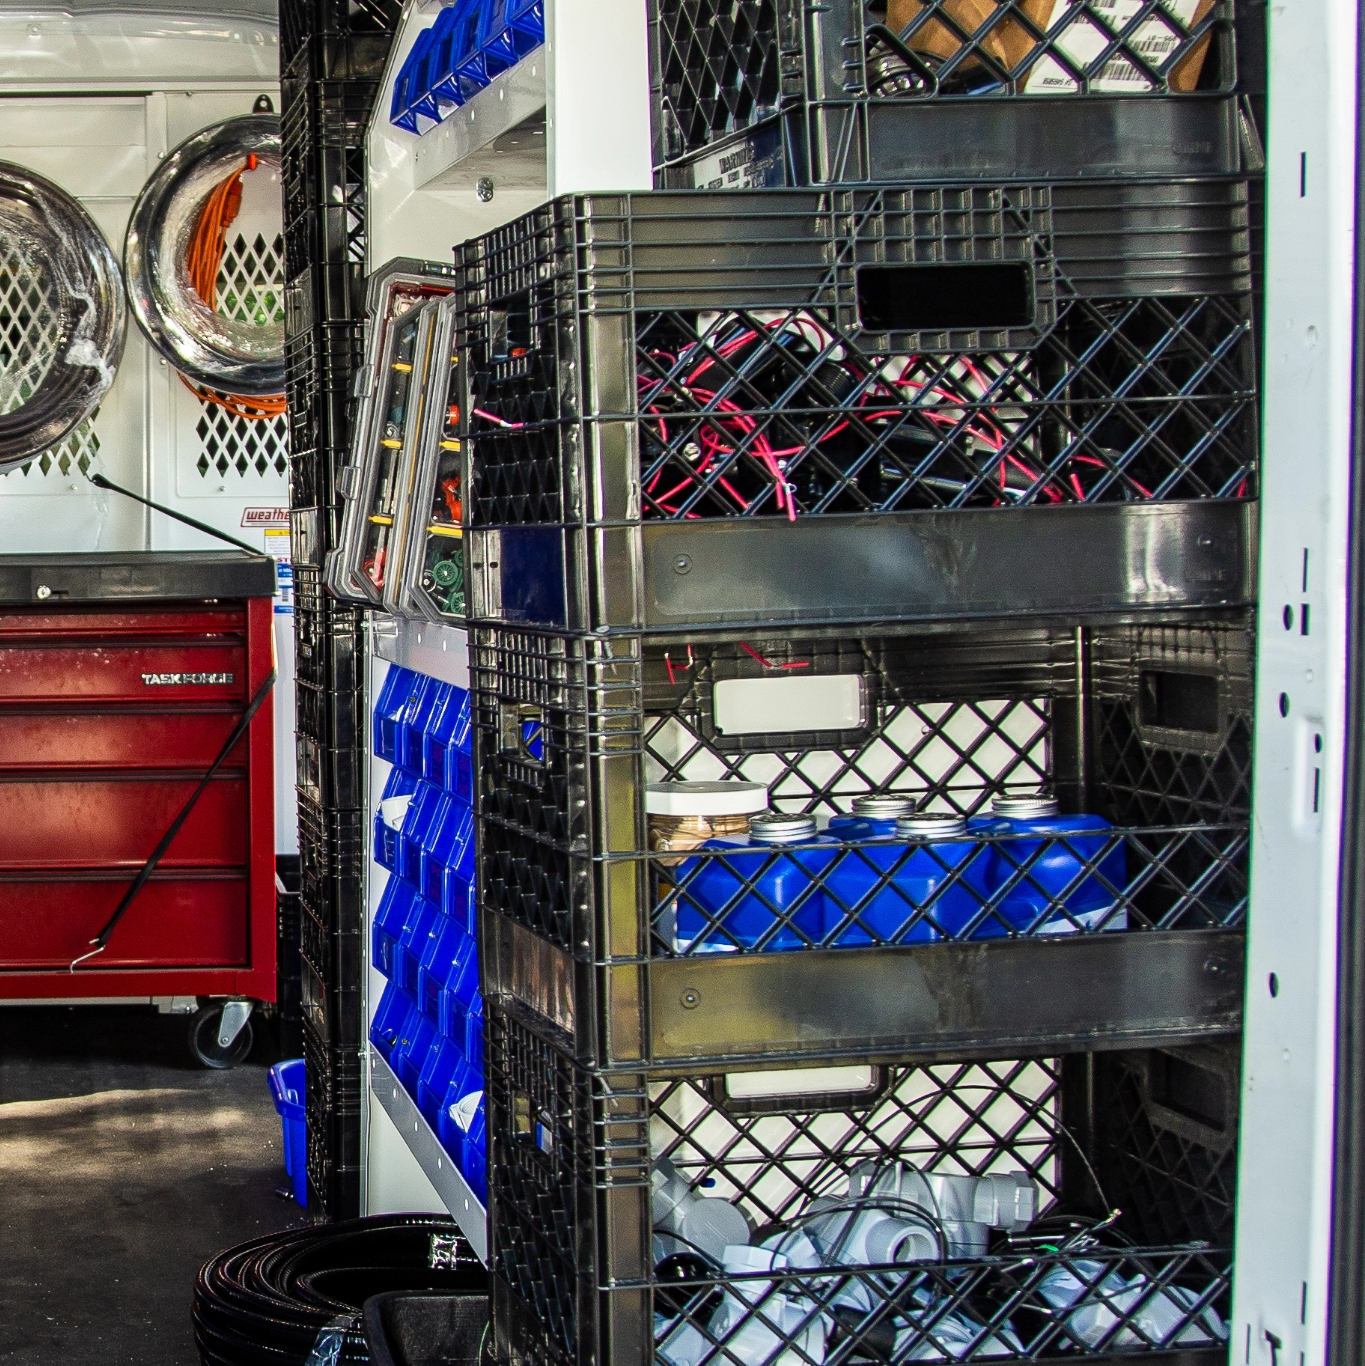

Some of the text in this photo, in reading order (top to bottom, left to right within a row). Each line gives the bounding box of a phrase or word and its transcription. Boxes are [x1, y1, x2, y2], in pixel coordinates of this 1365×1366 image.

[246, 508, 290, 521] weathe
[141, 672, 234, 685] TASK FORCE
